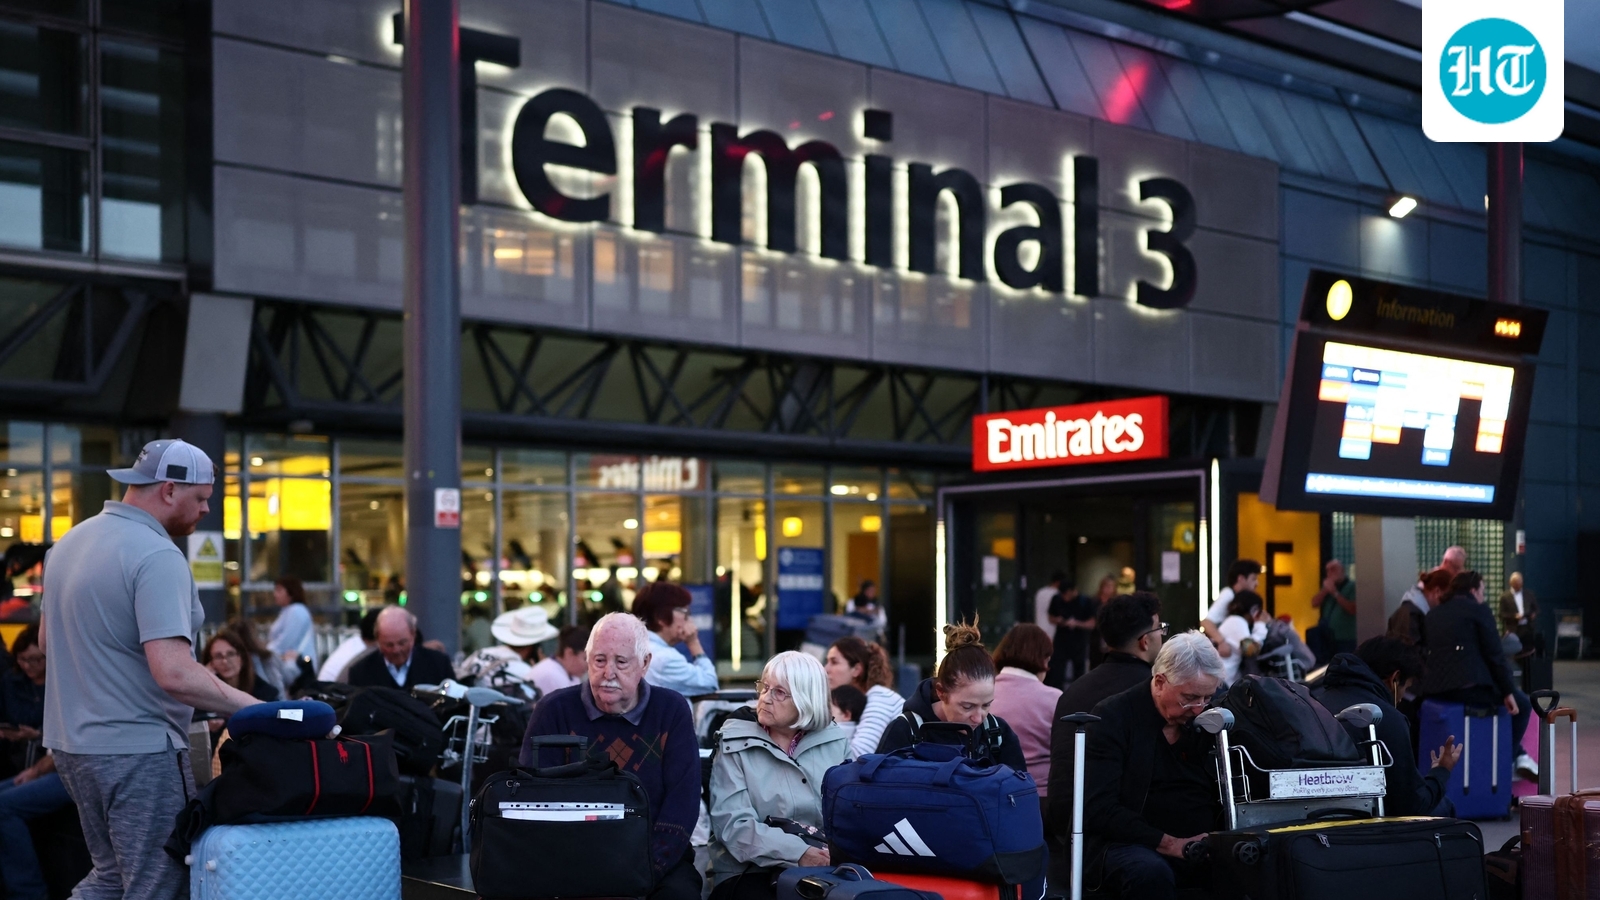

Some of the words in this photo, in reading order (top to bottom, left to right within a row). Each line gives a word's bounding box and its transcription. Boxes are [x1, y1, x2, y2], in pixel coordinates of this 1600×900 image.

[393, 13, 1099, 298] Terminal
[1136, 177, 1198, 310] 3
[1377, 298, 1455, 327] Information
[986, 411, 1145, 464] Emirates
[1266, 542, 1293, 619] F
[1298, 772, 1354, 785] Heathrow
